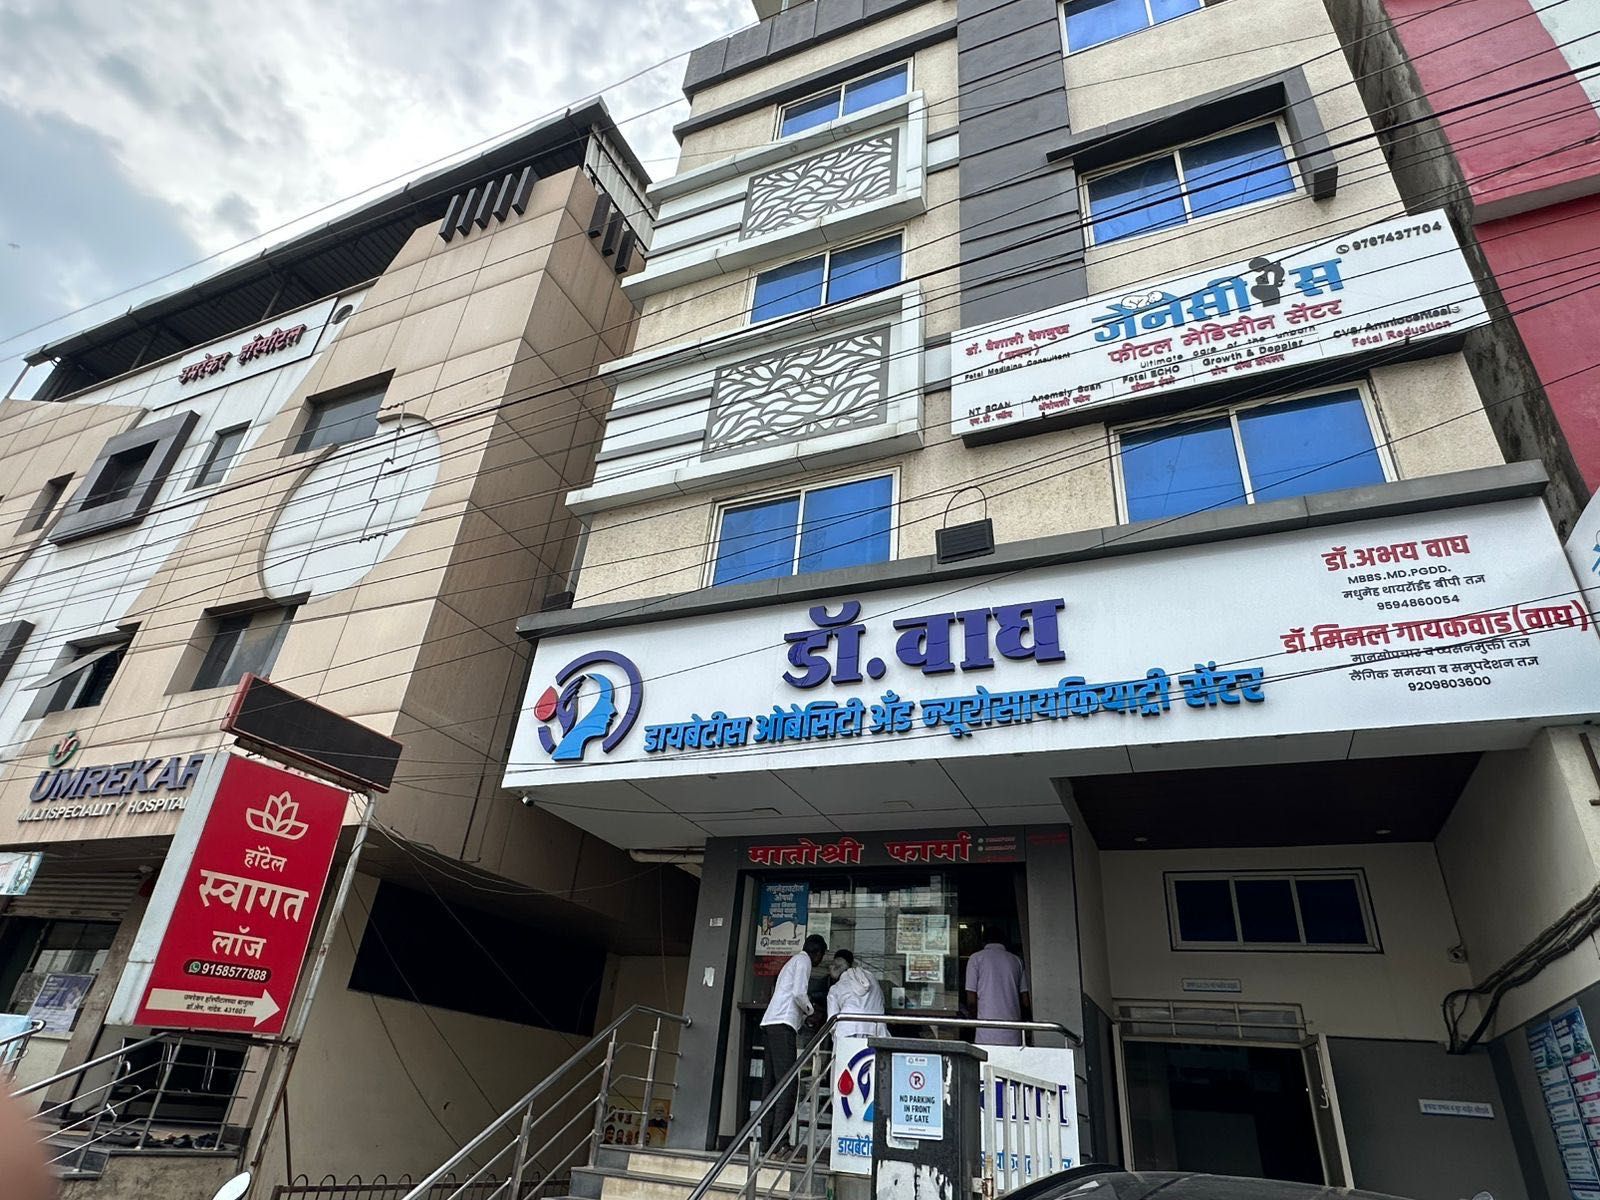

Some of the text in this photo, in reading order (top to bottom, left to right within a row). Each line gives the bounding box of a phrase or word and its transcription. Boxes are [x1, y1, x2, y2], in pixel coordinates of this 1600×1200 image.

[1108, 299, 1342, 364] फीटल मेडिसीन सेंटर
[1352, 319, 1452, 348] Fetal Reduction
[1140, 325, 1316, 368] Ultimate care of the unborn
[1202, 338, 1303, 367] Growth & Doppler
[964, 371, 983, 381] Fetal
[987, 363, 1023, 377] Medicine
[1026, 352, 1071, 366] Consultant
[1122, 364, 1180, 385] Fetal ECHO
[1031, 382, 1102, 404] Anomaly Scan
[968, 401, 1011, 417] NT SCAN
[1421, 534, 1471, 557] वाघ
[1341, 584, 1380, 601] मधुमेह
[1434, 575, 1461, 590] बीपी
[1464, 573, 1486, 586] तज्ञ
[1377, 593, 1460, 611] 9594860054
[1508, 636, 1530, 649] तज्ञ
[1349, 655, 1540, 682] लैंगिक समस्या व समुपदेशन तज्ञ
[1408, 675, 1492, 692] 9209803600
[644, 710, 752, 754] डायबेटीस
[753, 697, 867, 744] ओबेसिटी
[1178, 661, 1265, 709] सेंटर
[17, 801, 125, 823] MULTISPECIALITY
[243, 845, 287, 873] हॉटेल
[748, 830, 972, 867] मातोश्री फार्मा
[198, 868, 310, 923] स्वागत
[211, 925, 267, 960] लॉज
[201, 962, 267, 981] 9158577888
[899, 1095, 936, 1105] NO PARKING
[904, 1105, 931, 1114] IN FRONT
[905, 1114, 930, 1124] OF GATE
